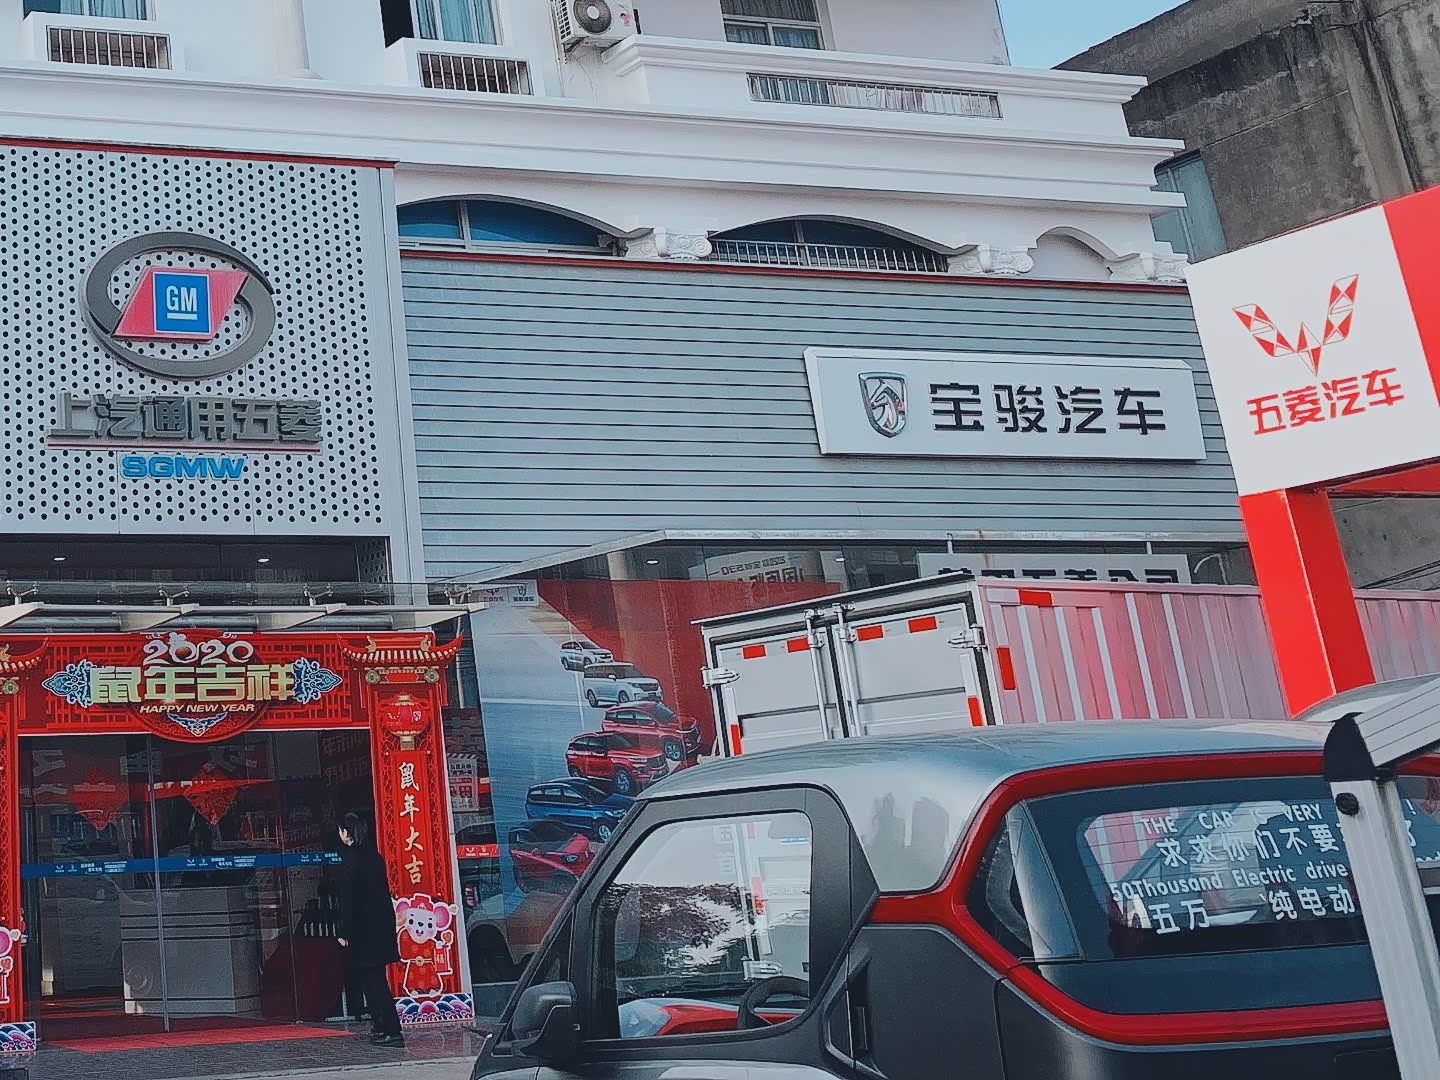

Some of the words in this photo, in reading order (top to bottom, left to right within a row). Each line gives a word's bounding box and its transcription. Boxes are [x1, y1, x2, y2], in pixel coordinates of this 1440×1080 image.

[166, 284, 198, 312] GM
[46, 390, 322, 444] 上汽通用五菱
[928, 382, 1167, 436] 宝骏汽车
[1246, 367, 1405, 436] 五菱汽车
[122, 455, 246, 480] SGMW
[143, 634, 254, 665] 2020
[90, 663, 296, 704] 鼠年吉祥
[139, 704, 184, 714] HAPPY
[186, 704, 218, 713] NEW
[221, 703, 255, 712] YEAR
[398, 761, 424, 885] 鼠年大吉
[1140, 816, 1178, 835] THE
[1199, 811, 1233, 830] CAR
[1283, 803, 1322, 822] VERY
[1233, 863, 1297, 888] Electric
[1305, 860, 1349, 880] drive
[1268, 883, 1355, 920] 纯电动
